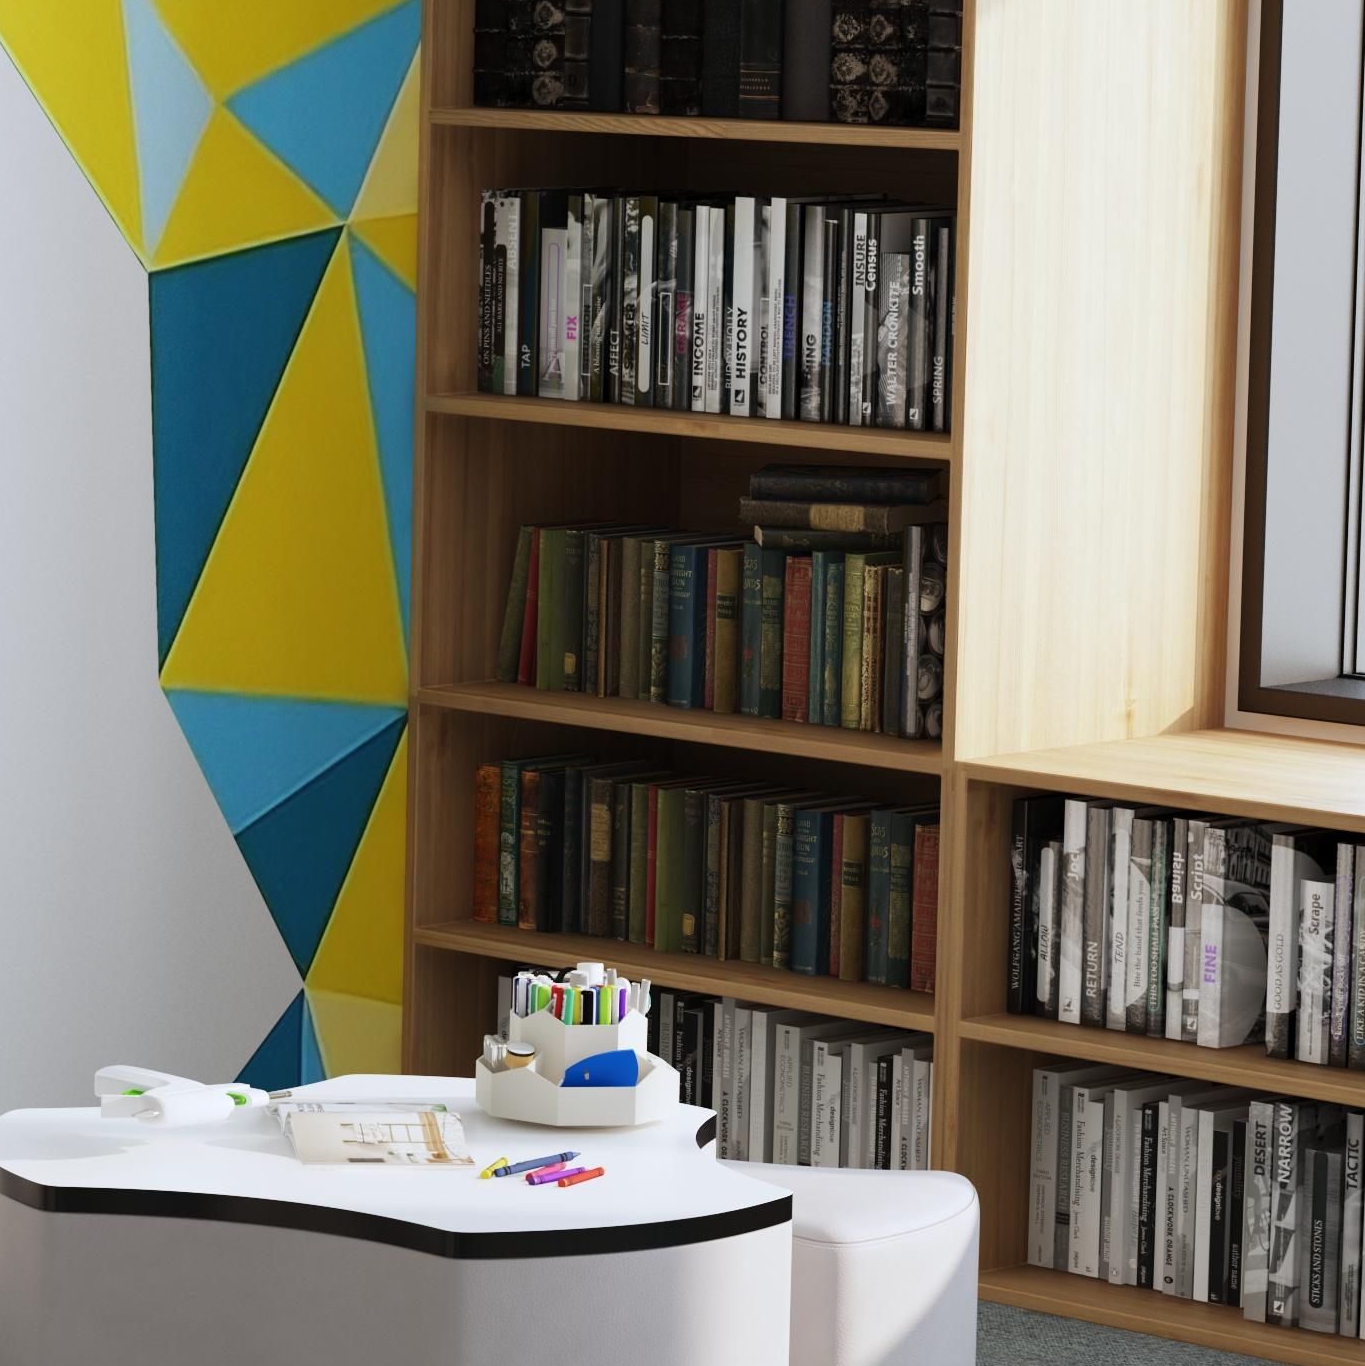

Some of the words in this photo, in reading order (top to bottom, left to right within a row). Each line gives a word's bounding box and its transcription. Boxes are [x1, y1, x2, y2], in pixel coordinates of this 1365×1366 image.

[856, 235, 865, 286] INSURE
[866, 238, 877, 292] Census
[913, 235, 925, 296] Smooth
[484, 265, 492, 305] NEEDLES
[484, 306, 492, 327] AND
[566, 316, 577, 340] FIX
[641, 312, 650, 345] LIMIT
[888, 281, 900, 347] CRONKITE
[483, 328, 491, 348] PINS
[483, 349, 491, 364] ON
[521, 344, 531, 368] TAP
[609, 330, 619, 375] AFFECT
[693, 313, 704, 376] INCOME
[736, 307, 748, 379] HISTORY
[760, 324, 769, 385] CONTROL
[886, 351, 898, 406] WALTER
[933, 356, 943, 404] SPRING
[1191, 854, 1204, 900] Script
[1013, 880, 1023, 930] AMADEUS
[1308, 894, 1323, 935] Scrape
[1011, 932, 1021, 989] WOLFGANG
[1041, 924, 1049, 961] ALLOW
[1115, 932, 1123, 964] TEND
[1276, 934, 1284, 963] GOLD
[1086, 941, 1098, 997] RETURN
[1133, 971, 1141, 987] Bite
[1204, 944, 1217, 983] FINE
[1276, 965, 1283, 977] AS
[1358, 966, 1365, 974] A
[1358, 976, 1365, 987] IN
[1149, 984, 1157, 1007] THIS
[1274, 980, 1282, 1010] GOOD
[1357, 989, 1365, 1006] KID
[1357, 1008, 1365, 1016] A
[677, 1031, 685, 1061] Fashion
[1356, 1017, 1365, 1040] LIKE
[801, 1065, 810, 1108] BUSINESS
[816, 1073, 825, 1100] Fashion
[878, 1089, 887, 1116] Fashion
[799, 1110, 809, 1161] RESEARCH
[813, 1103, 824, 1156] Merchandising
[1036, 1101, 1044, 1162] ECONOMETRICS
[1044, 1101, 1052, 1135] APPLIED
[1060, 1112, 1070, 1158] BUSINESS
[1075, 1120, 1085, 1149] Fashion
[1143, 1137, 1153, 1165] Fashion
[1254, 1121, 1266, 1176] DESERT
[1277, 1104, 1293, 1183] NARROW
[1072, 1151, 1084, 1206] Merchandising
[1347, 1138, 1359, 1190] TACTIC
[1058, 1160, 1068, 1211] RESEARCH
[1139, 1167, 1152, 1222] Merchandising
[1166, 1194, 1174, 1236] CLOCKWORK
[1165, 1239, 1173, 1266] ORANGE
[1314, 1220, 1323, 1252] STONES
[1231, 1244, 1239, 1268] author
[1313, 1253, 1322, 1272] AND
[1230, 1269, 1238, 1290] name
[1312, 1273, 1321, 1303] STICKS
